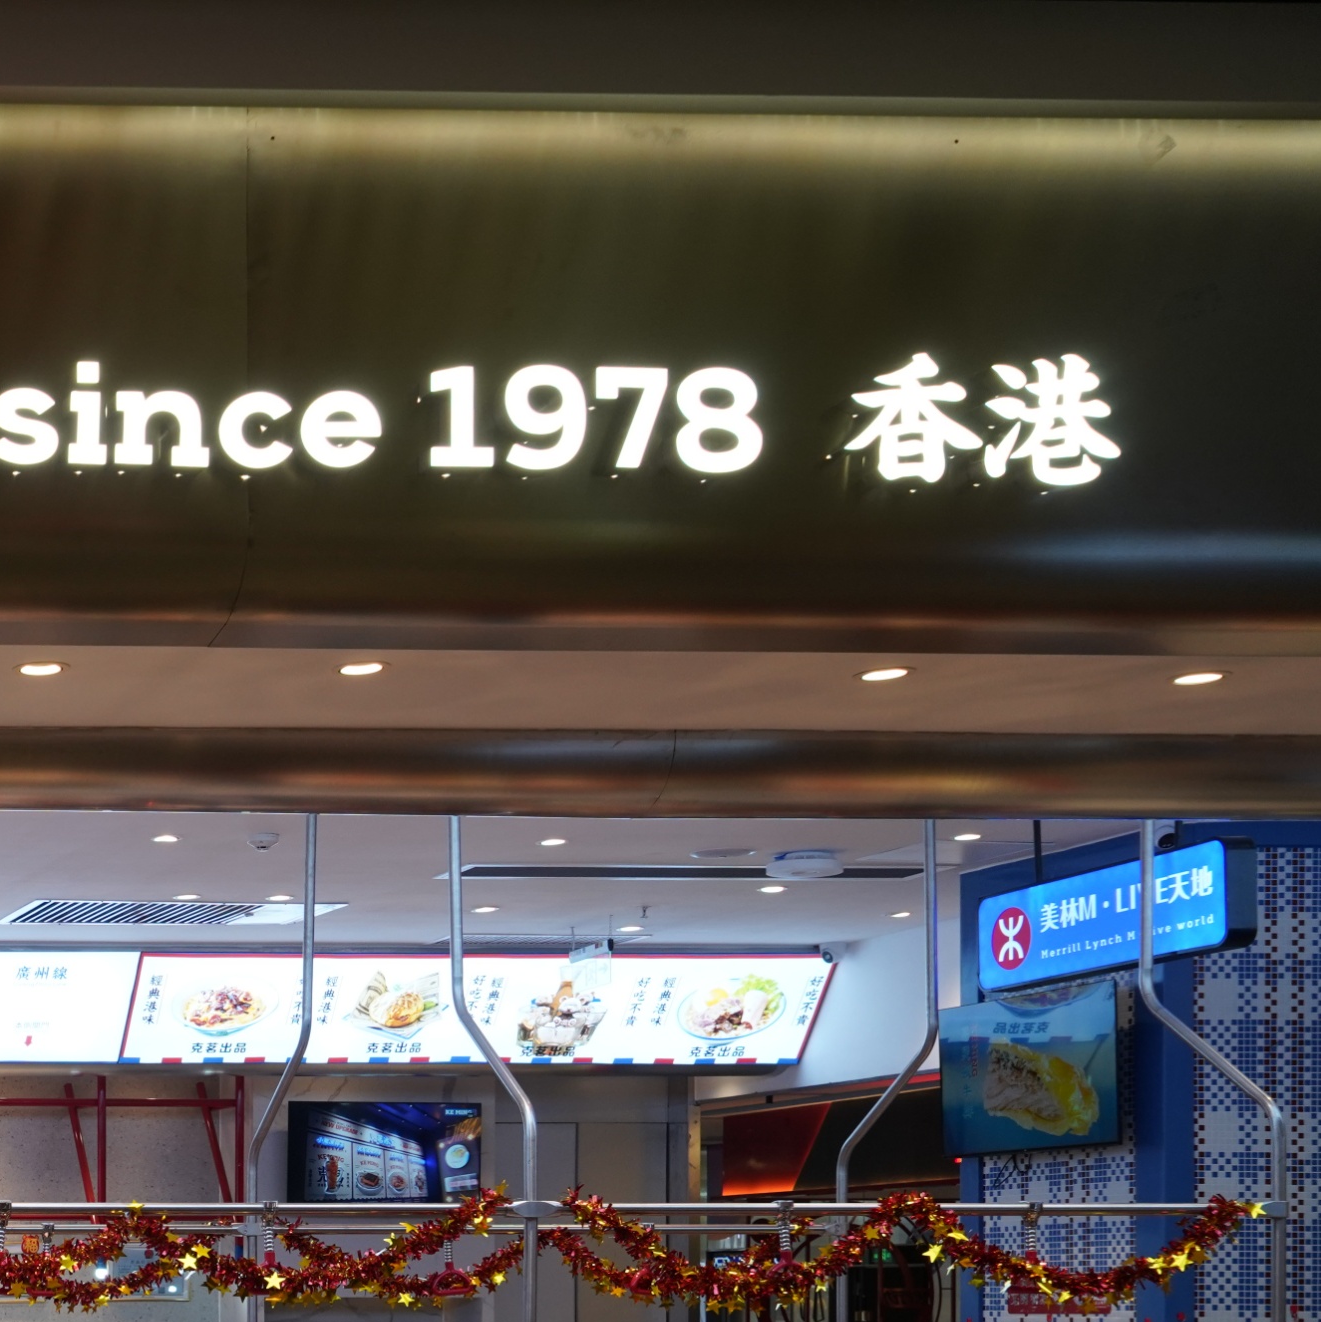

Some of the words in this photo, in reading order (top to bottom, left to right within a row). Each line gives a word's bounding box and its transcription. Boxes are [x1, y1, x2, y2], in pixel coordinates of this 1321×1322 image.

[427, 364, 764, 472] 1978
[845, 352, 1121, 487] 香港
[1039, 864, 1214, 934] 美林M·LIE天地
[1041, 943, 1082, 960] Merrill
[1086, 934, 1124, 952] Lynch
[1177, 913, 1215, 932] world
[15, 965, 68, 980] 廣州線
[142, 974, 164, 1026] 經典港味
[316, 975, 339, 1026] 經典港味
[479, 976, 504, 1027] 經典港味
[625, 975, 651, 1027] 好吃不貴
[651, 975, 676, 1027] 經典港味
[796, 975, 825, 1027] 好吃不貴
[191, 1041, 247, 1054] 克茗出品
[366, 1042, 422, 1055] 克茗出品
[689, 1045, 746, 1058] 克茗出品
